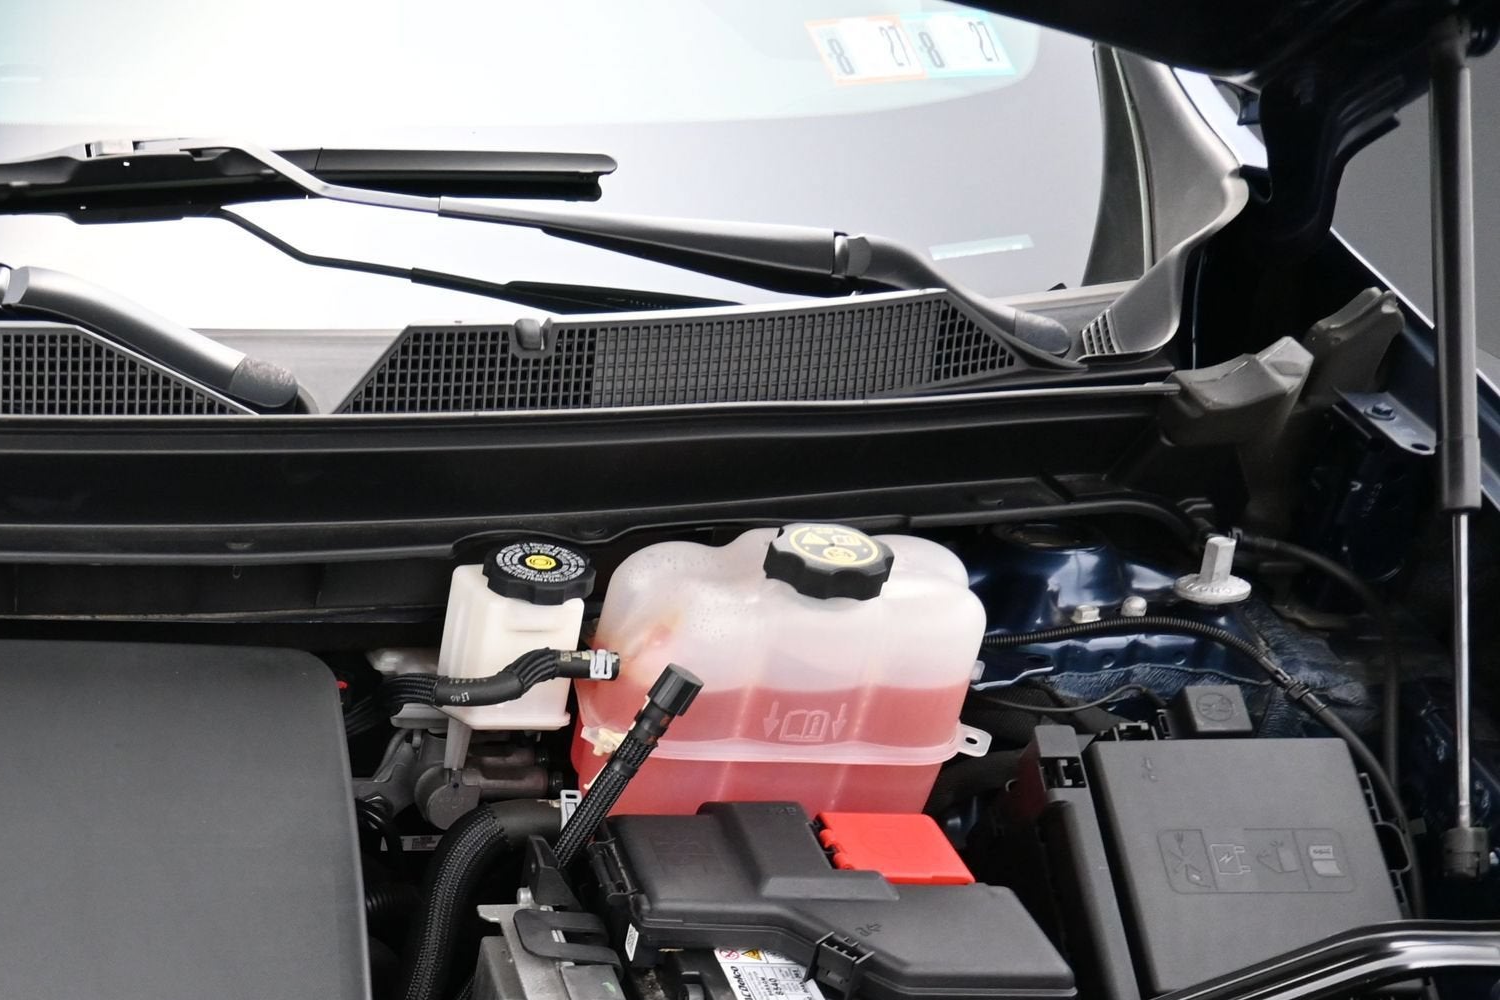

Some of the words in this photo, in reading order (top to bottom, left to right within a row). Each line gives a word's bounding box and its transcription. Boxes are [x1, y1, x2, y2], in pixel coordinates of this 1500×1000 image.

[878, 25, 912, 67] 27
[918, 31, 945, 69] 8
[967, 20, 1001, 62] 27
